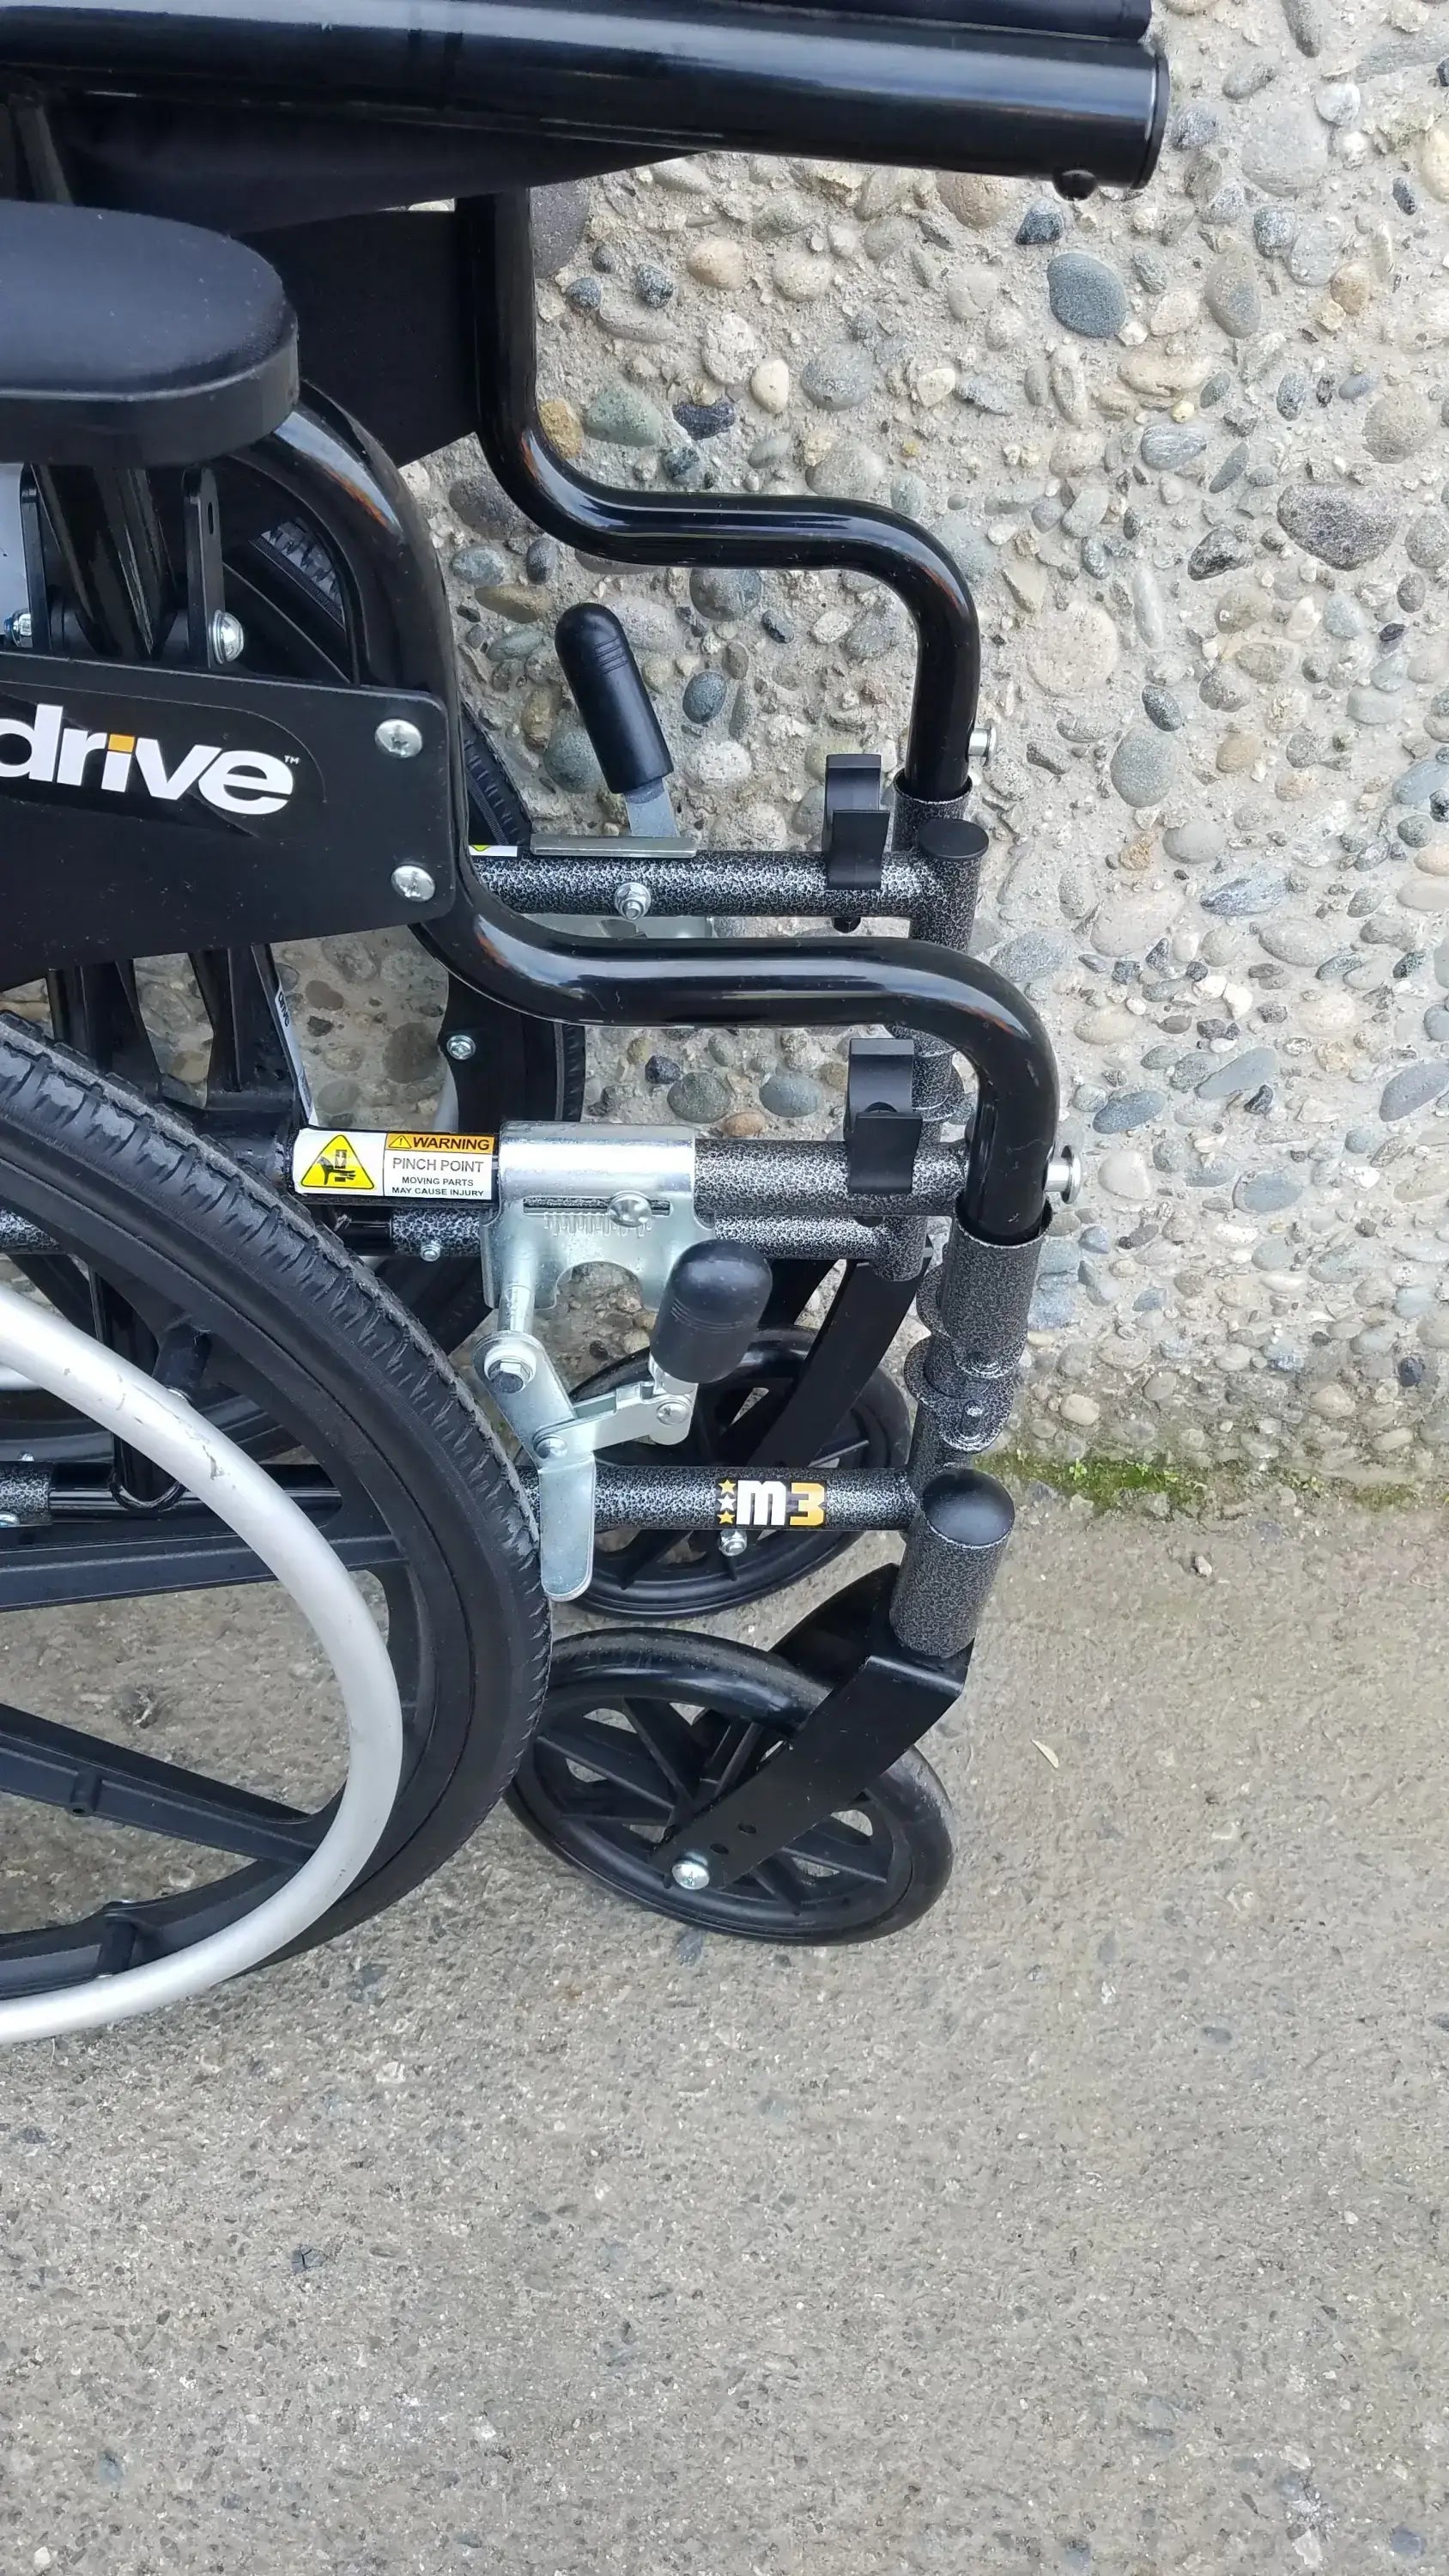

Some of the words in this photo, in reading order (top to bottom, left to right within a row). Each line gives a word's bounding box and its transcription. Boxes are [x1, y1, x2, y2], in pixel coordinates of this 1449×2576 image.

[0, 703, 293, 815] drive
[413, 1137, 490, 1151] WARNING
[392, 1157, 437, 1170] PINCH
[440, 1159, 484, 1173] POINT
[402, 1176, 440, 1185] MOVING
[443, 1178, 474, 1187] PARTS
[450, 1188, 484, 1197] INJURY
